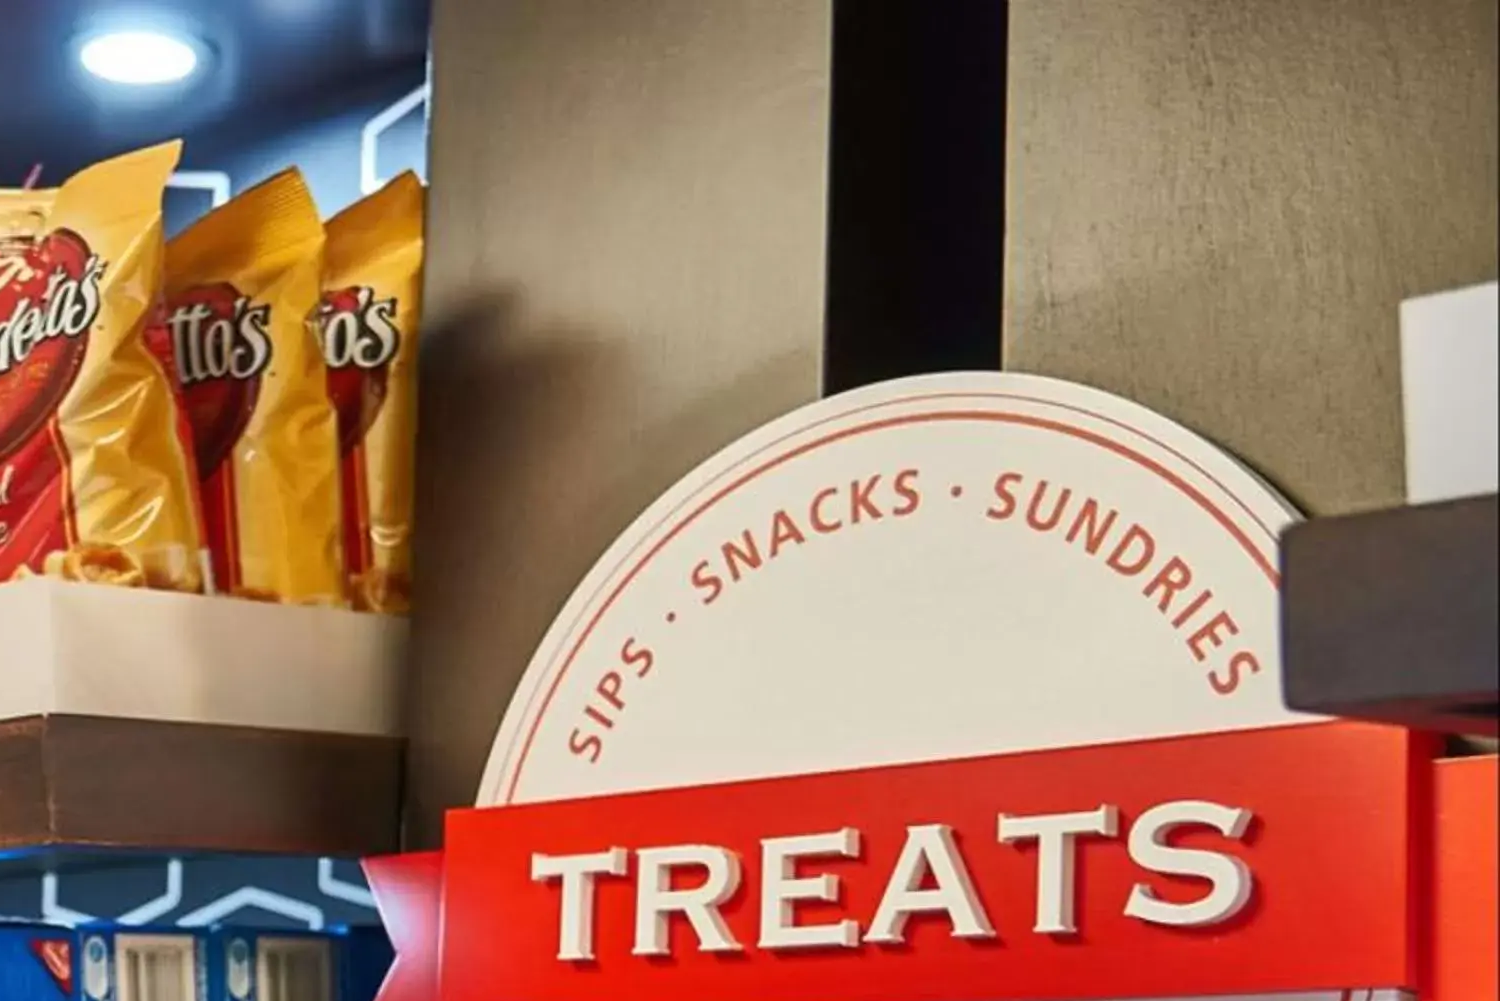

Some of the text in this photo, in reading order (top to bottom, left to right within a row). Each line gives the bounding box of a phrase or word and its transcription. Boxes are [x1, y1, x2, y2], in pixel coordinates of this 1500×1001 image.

[568, 469, 1260, 761] SIPS SNACKS SUNDRIES
[530, 799, 1254, 961] TREATS
